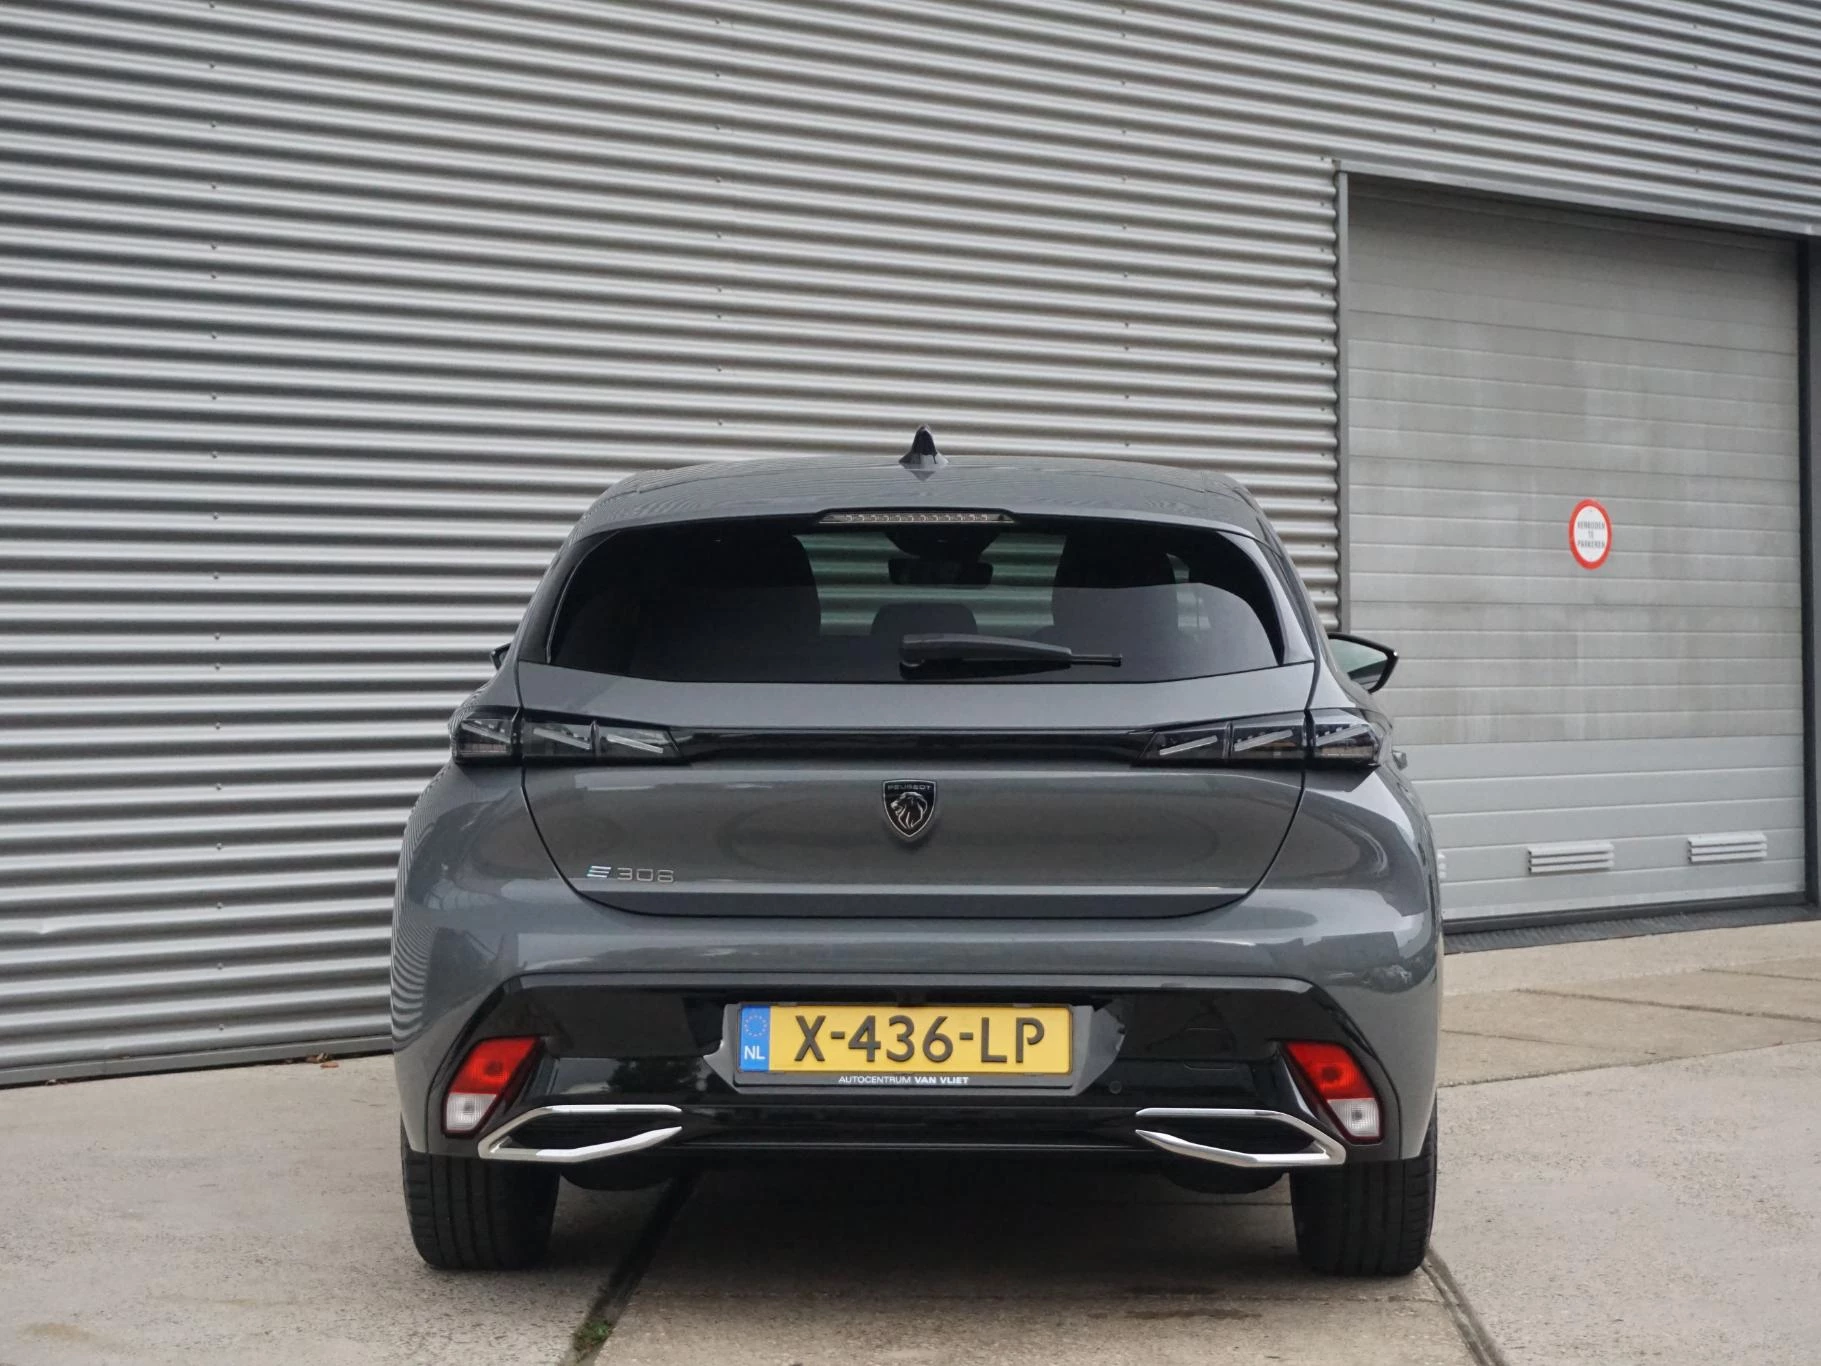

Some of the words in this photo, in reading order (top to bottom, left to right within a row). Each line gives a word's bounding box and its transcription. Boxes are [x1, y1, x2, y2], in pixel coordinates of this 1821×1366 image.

[1577, 540, 1605, 548] PARKEREN
[744, 1045, 766, 1061] NL
[794, 1014, 1045, 1064] X-436-LP
[838, 1075, 911, 1084] AUTOCENTRUM
[914, 1076, 937, 1084] VAN
[939, 1076, 969, 1085] VLIET
